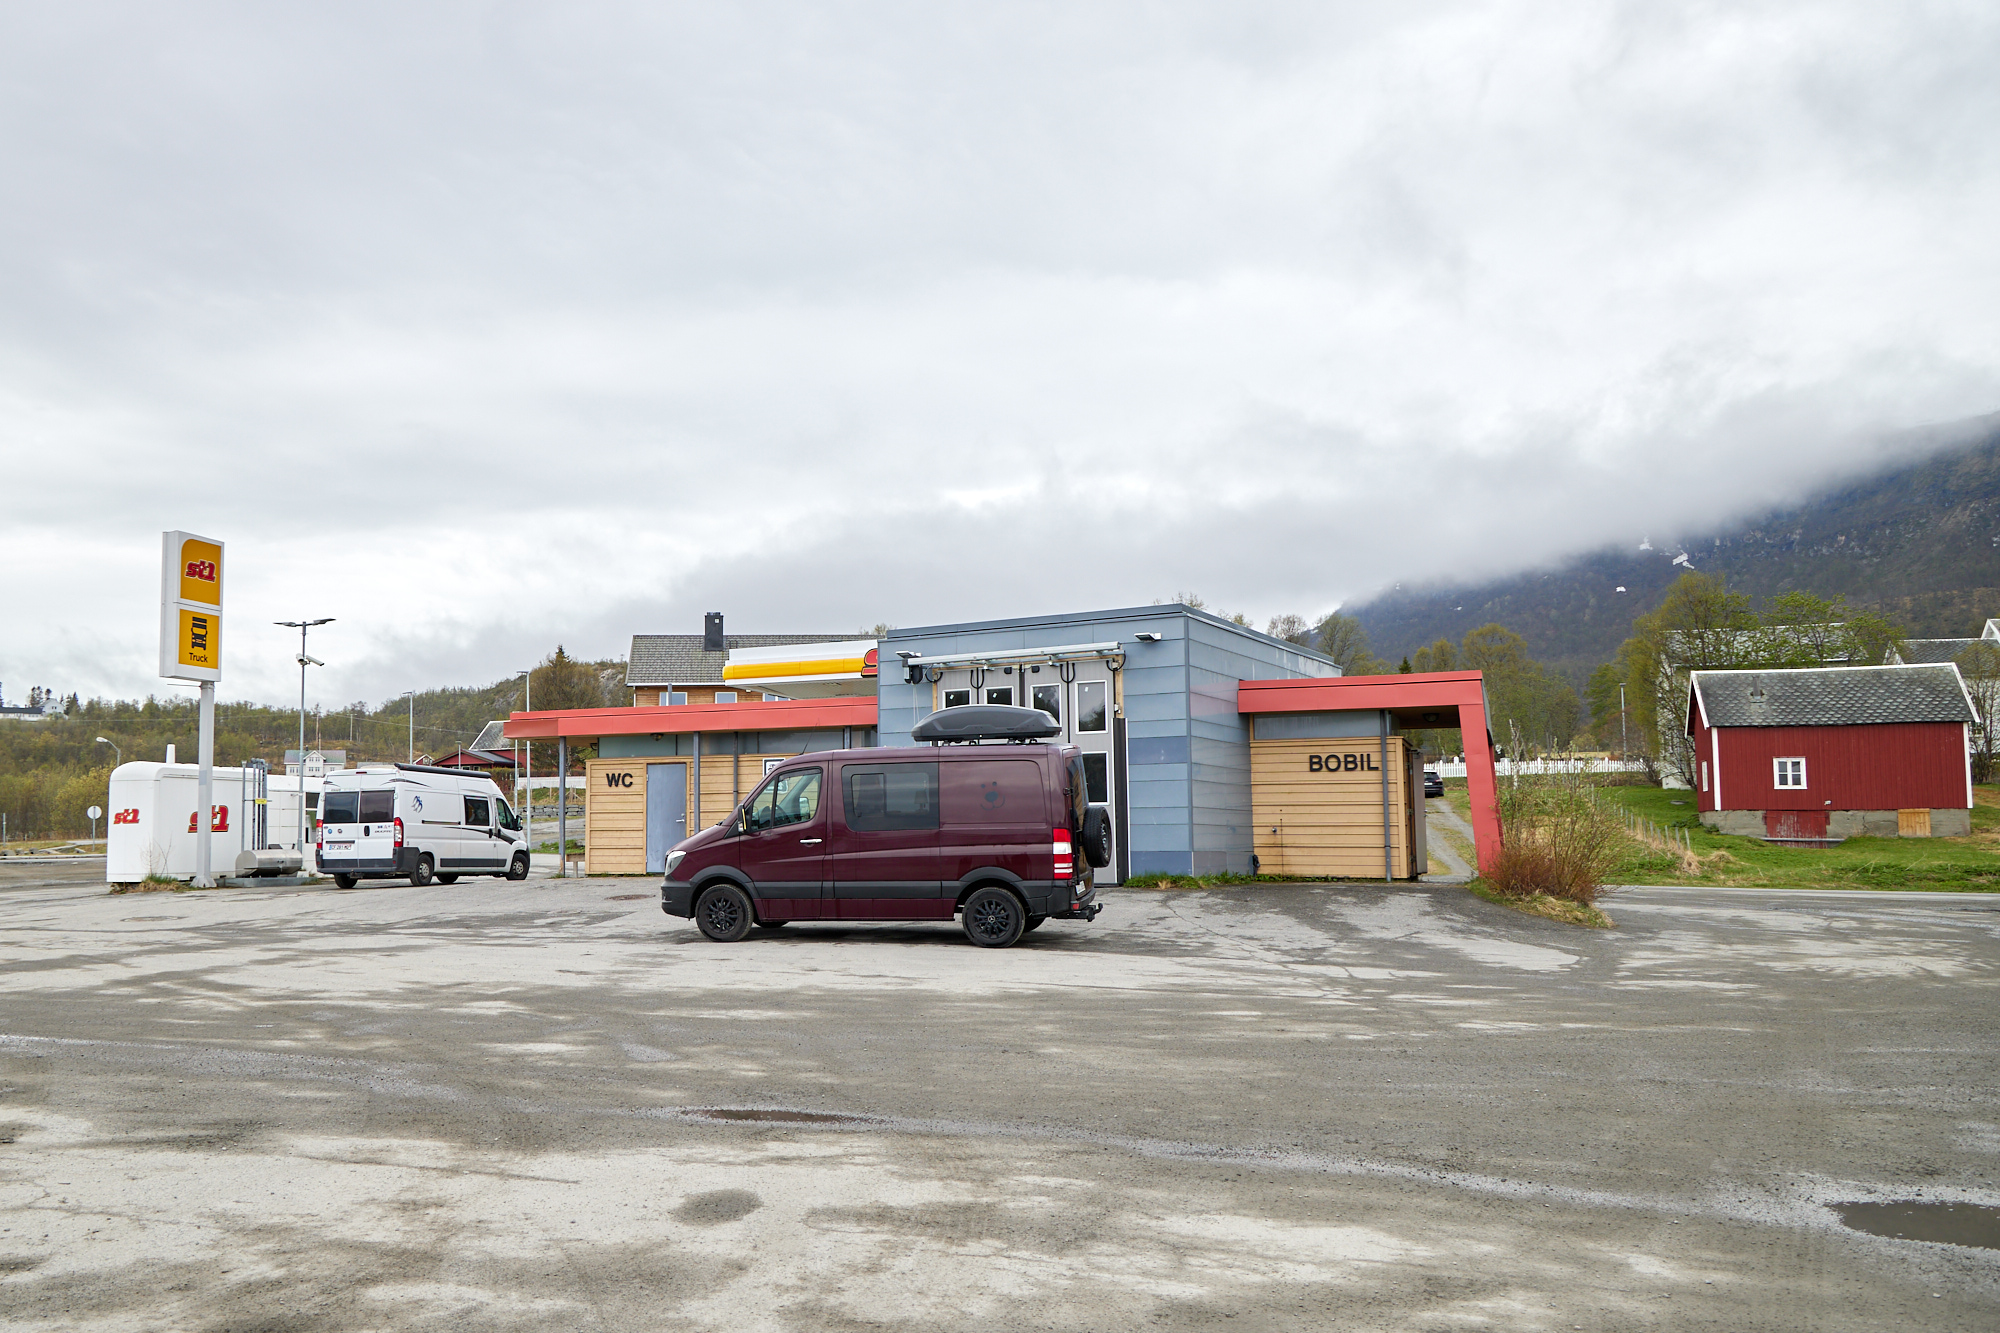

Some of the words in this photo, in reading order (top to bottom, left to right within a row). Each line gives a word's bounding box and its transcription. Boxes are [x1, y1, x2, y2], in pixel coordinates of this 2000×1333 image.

[189, 652, 208, 663] Truck
[1309, 753, 1379, 772] BOBIL
[606, 773, 633, 788] WC
